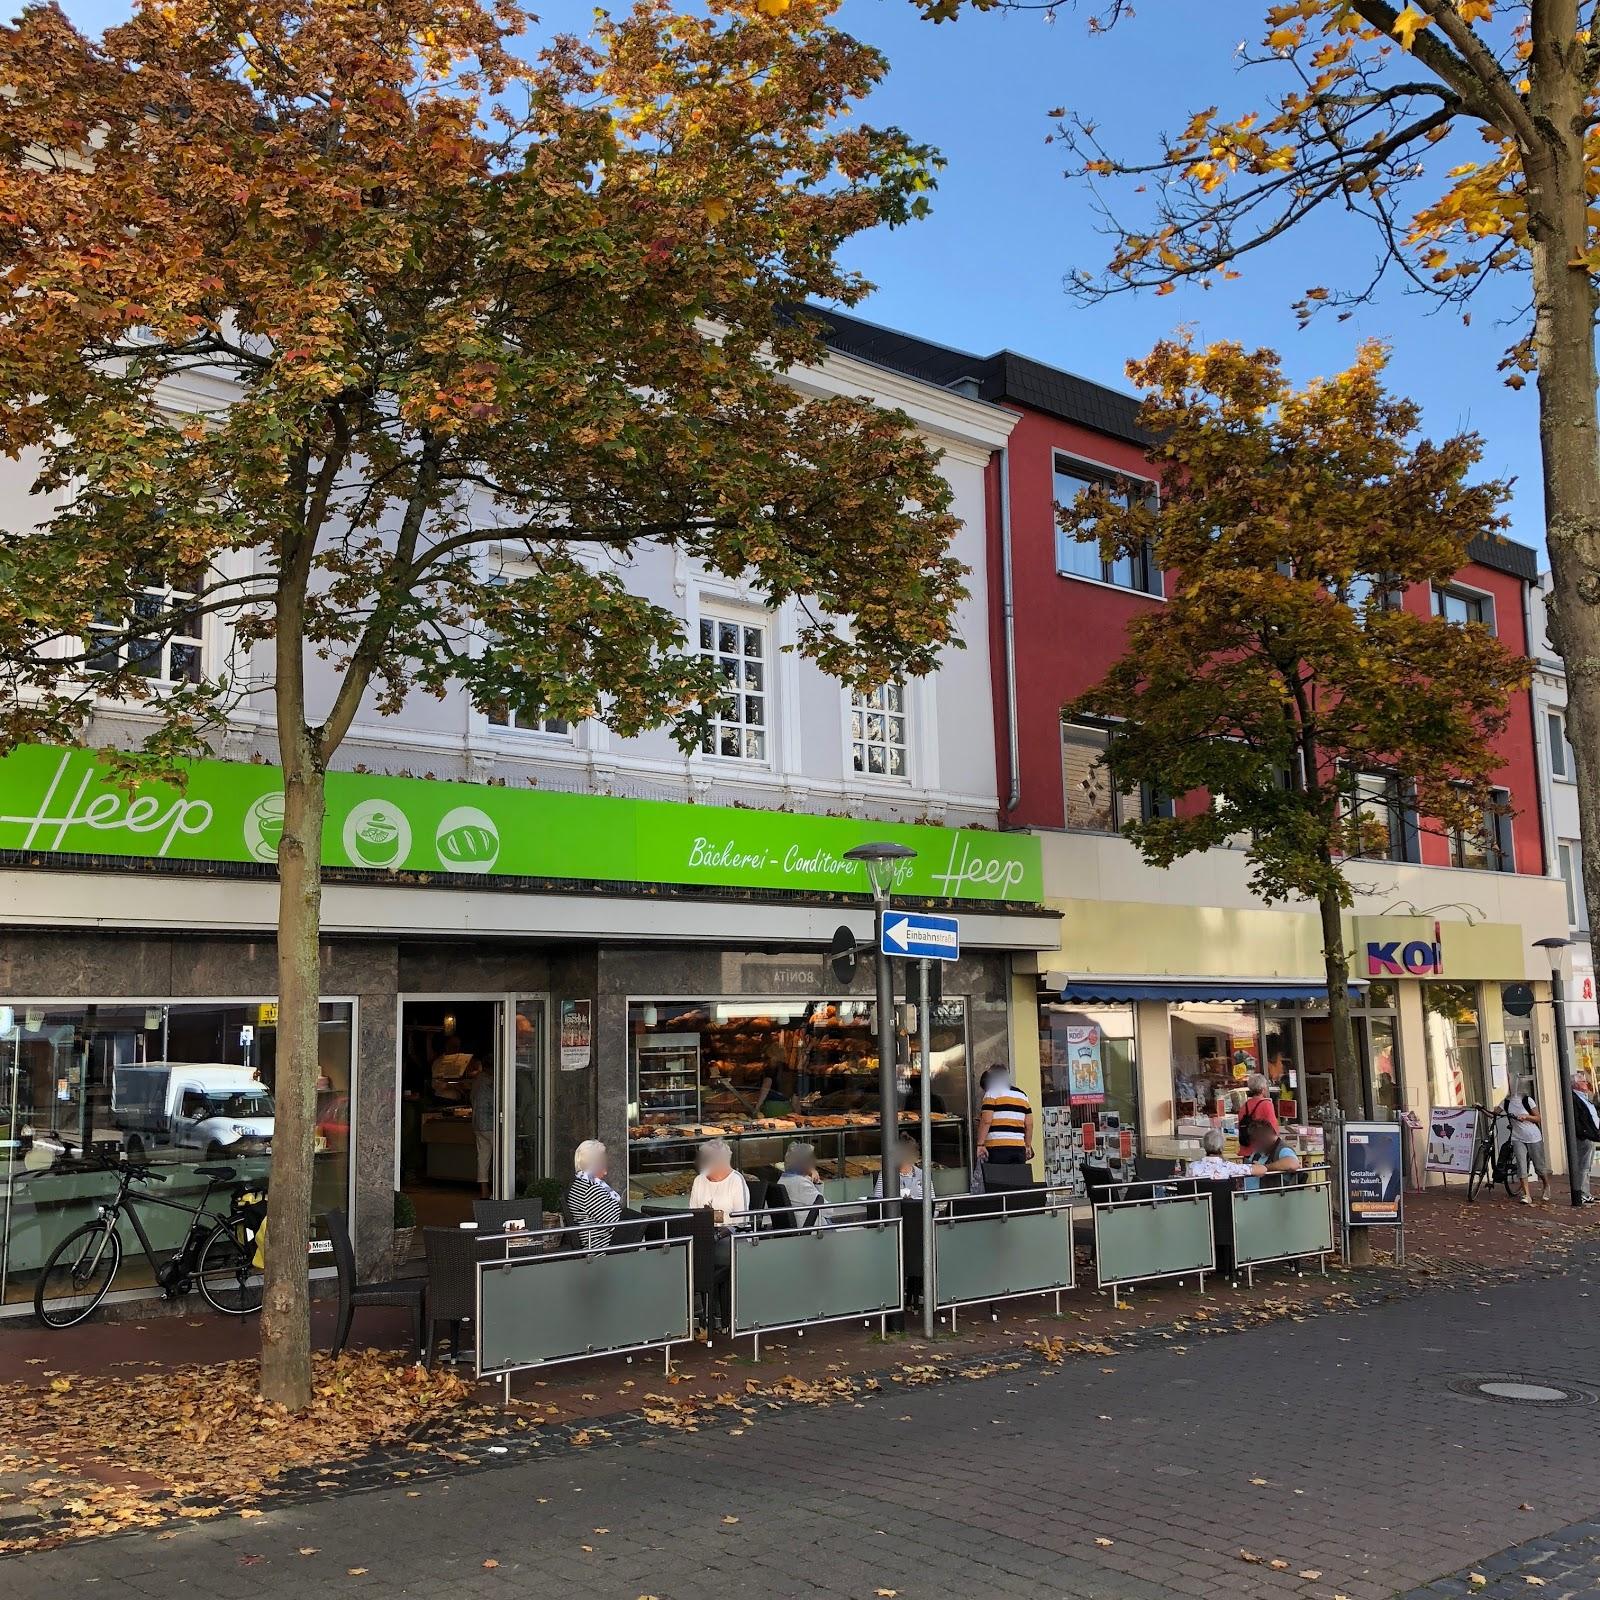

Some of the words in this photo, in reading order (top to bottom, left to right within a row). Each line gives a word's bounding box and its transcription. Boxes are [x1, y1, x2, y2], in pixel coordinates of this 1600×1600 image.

[0, 752, 213, 857] Heep
[688, 837, 768, 869] Bäckerei
[783, 844, 858, 874] Conditorei
[932, 832, 1024, 899] Heep
[906, 929, 955, 944] Einbahnstraße
